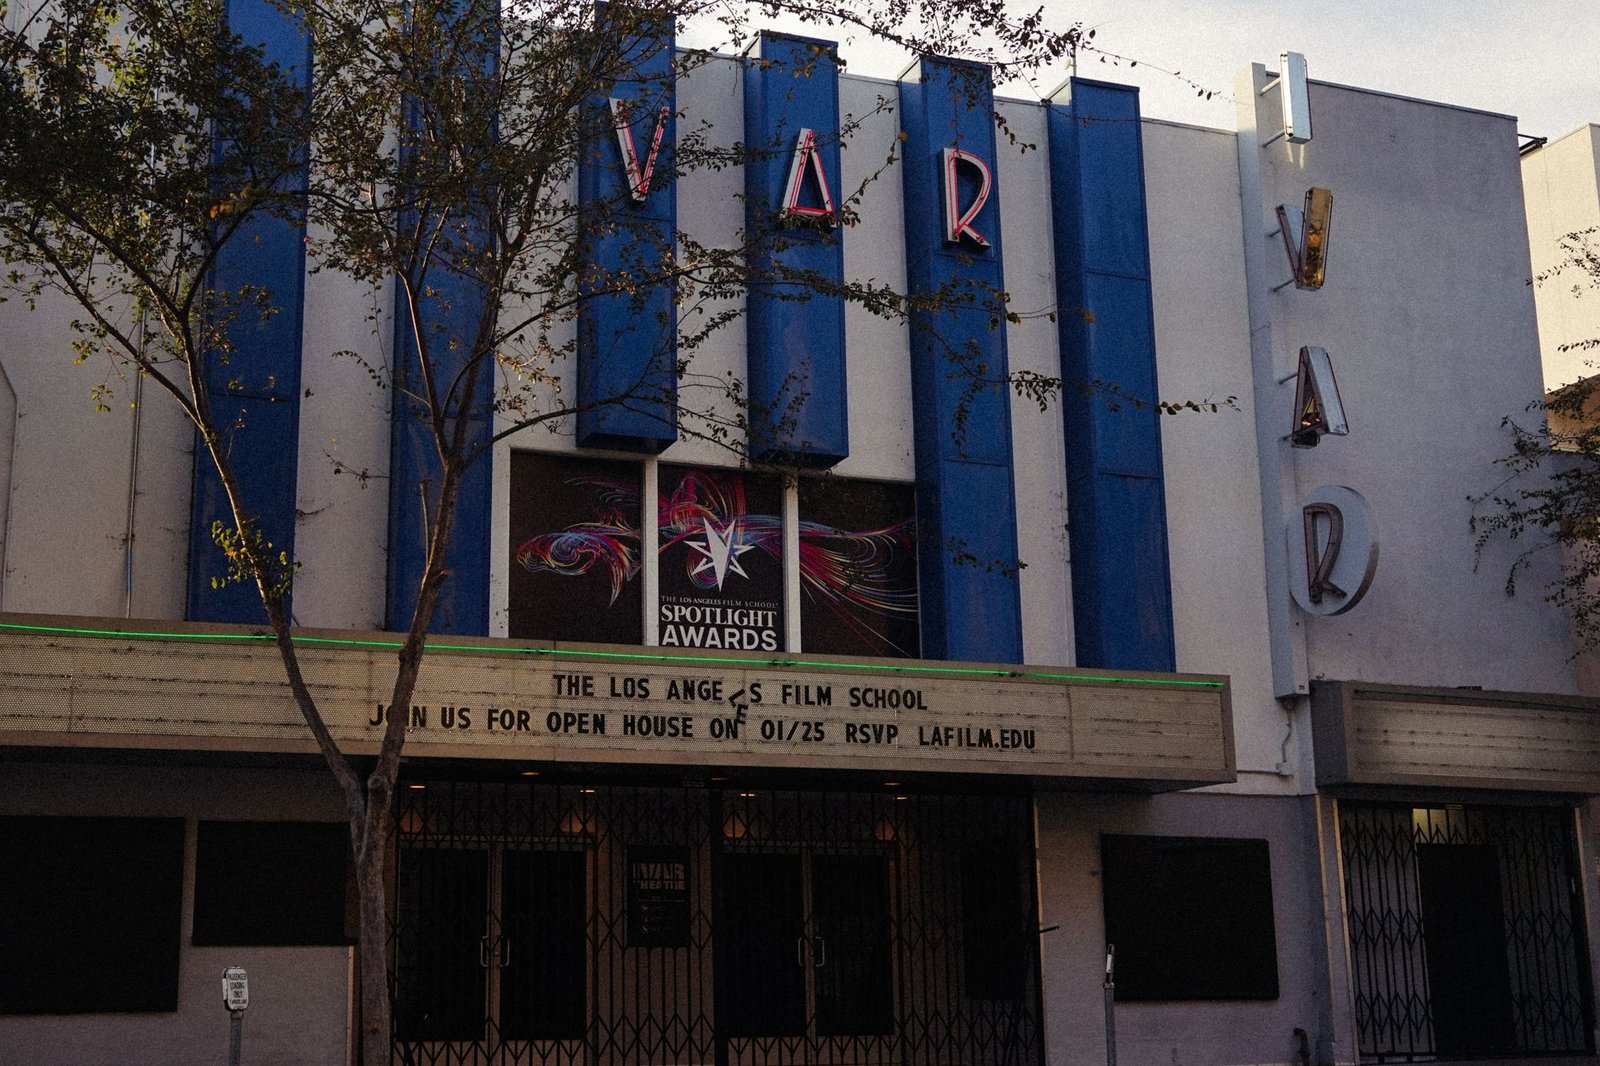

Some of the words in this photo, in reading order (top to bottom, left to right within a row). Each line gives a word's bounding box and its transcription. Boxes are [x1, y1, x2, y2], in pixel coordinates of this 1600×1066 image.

[661, 595, 677, 603] THE
[680, 596, 692, 604] LOS
[693, 597, 721, 605] ANGELES
[722, 599, 742, 607] FILM
[661, 604, 777, 628] SPOTLIGHT
[661, 624, 778, 652] AWARDS
[553, 674, 594, 698] THE
[610, 676, 650, 699] LOS
[782, 684, 832, 707] FILM
[850, 687, 928, 711] SCHOOL
[369, 704, 427, 728] JN
[440, 705, 471, 729] US
[487, 708, 531, 732] FOR
[547, 711, 606, 735] OPEN
[623, 714, 694, 738] HOUSE
[709, 717, 739, 739] ON
[845, 722, 899, 745] RSVP
[918, 726, 1036, 750] LAFILM.EDU
